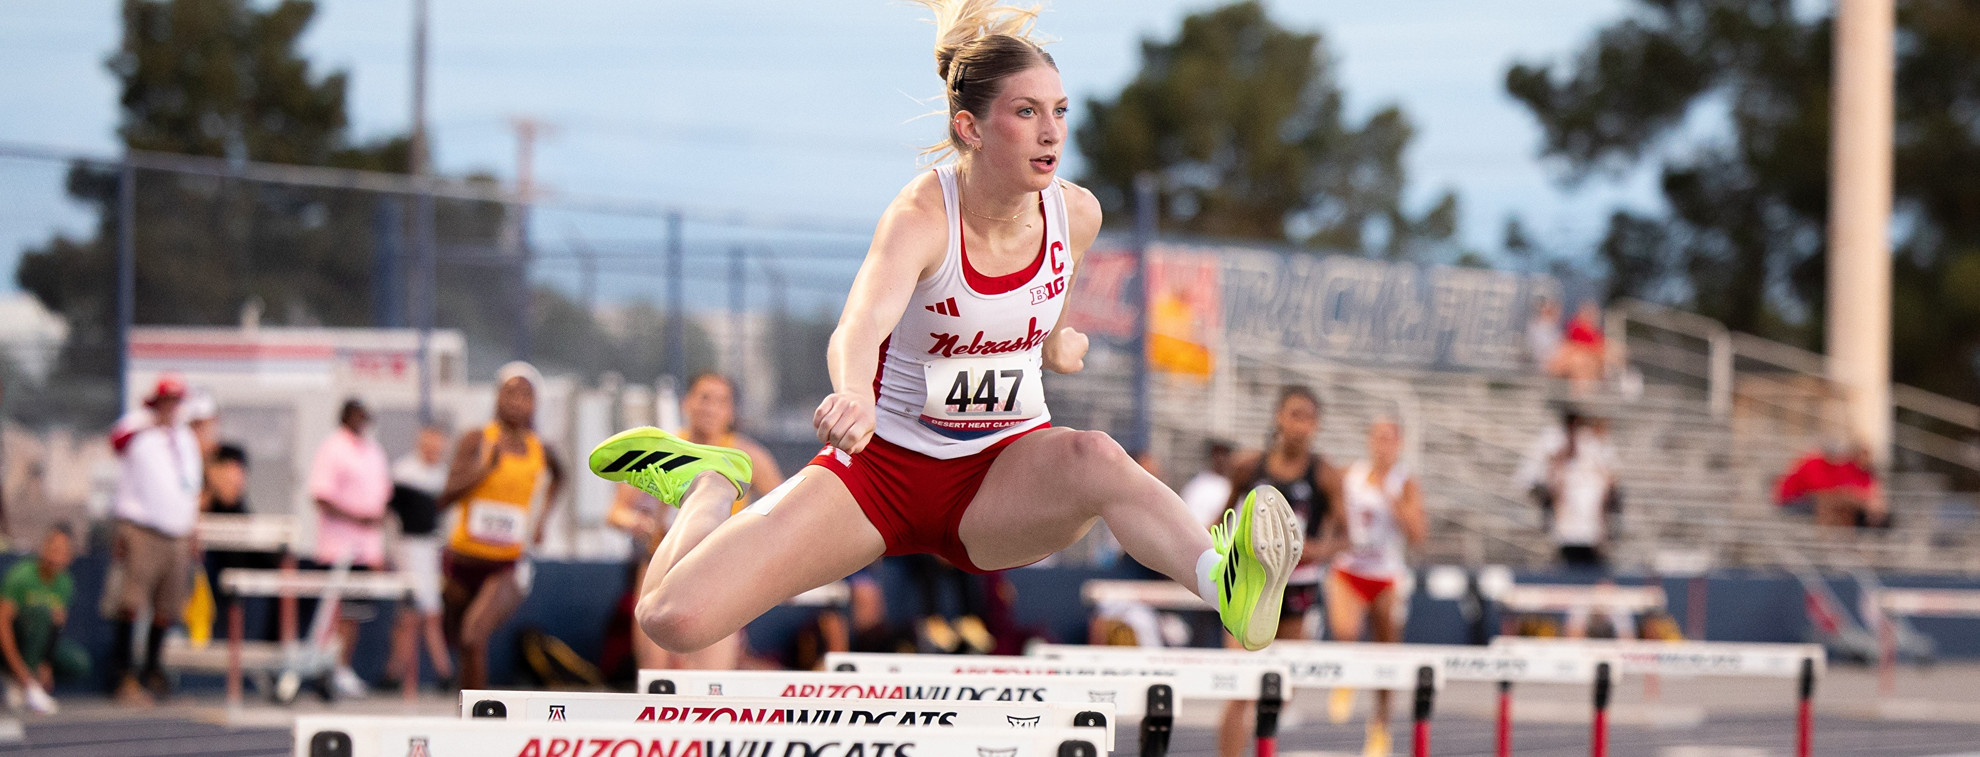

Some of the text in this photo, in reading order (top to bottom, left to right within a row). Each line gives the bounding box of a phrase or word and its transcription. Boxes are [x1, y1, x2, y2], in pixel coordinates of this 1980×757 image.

[1050, 241, 1065, 275] C
[945, 369, 1024, 412] 447
[931, 420, 967, 428] DESERT
[993, 420, 1025, 428] CLASS
